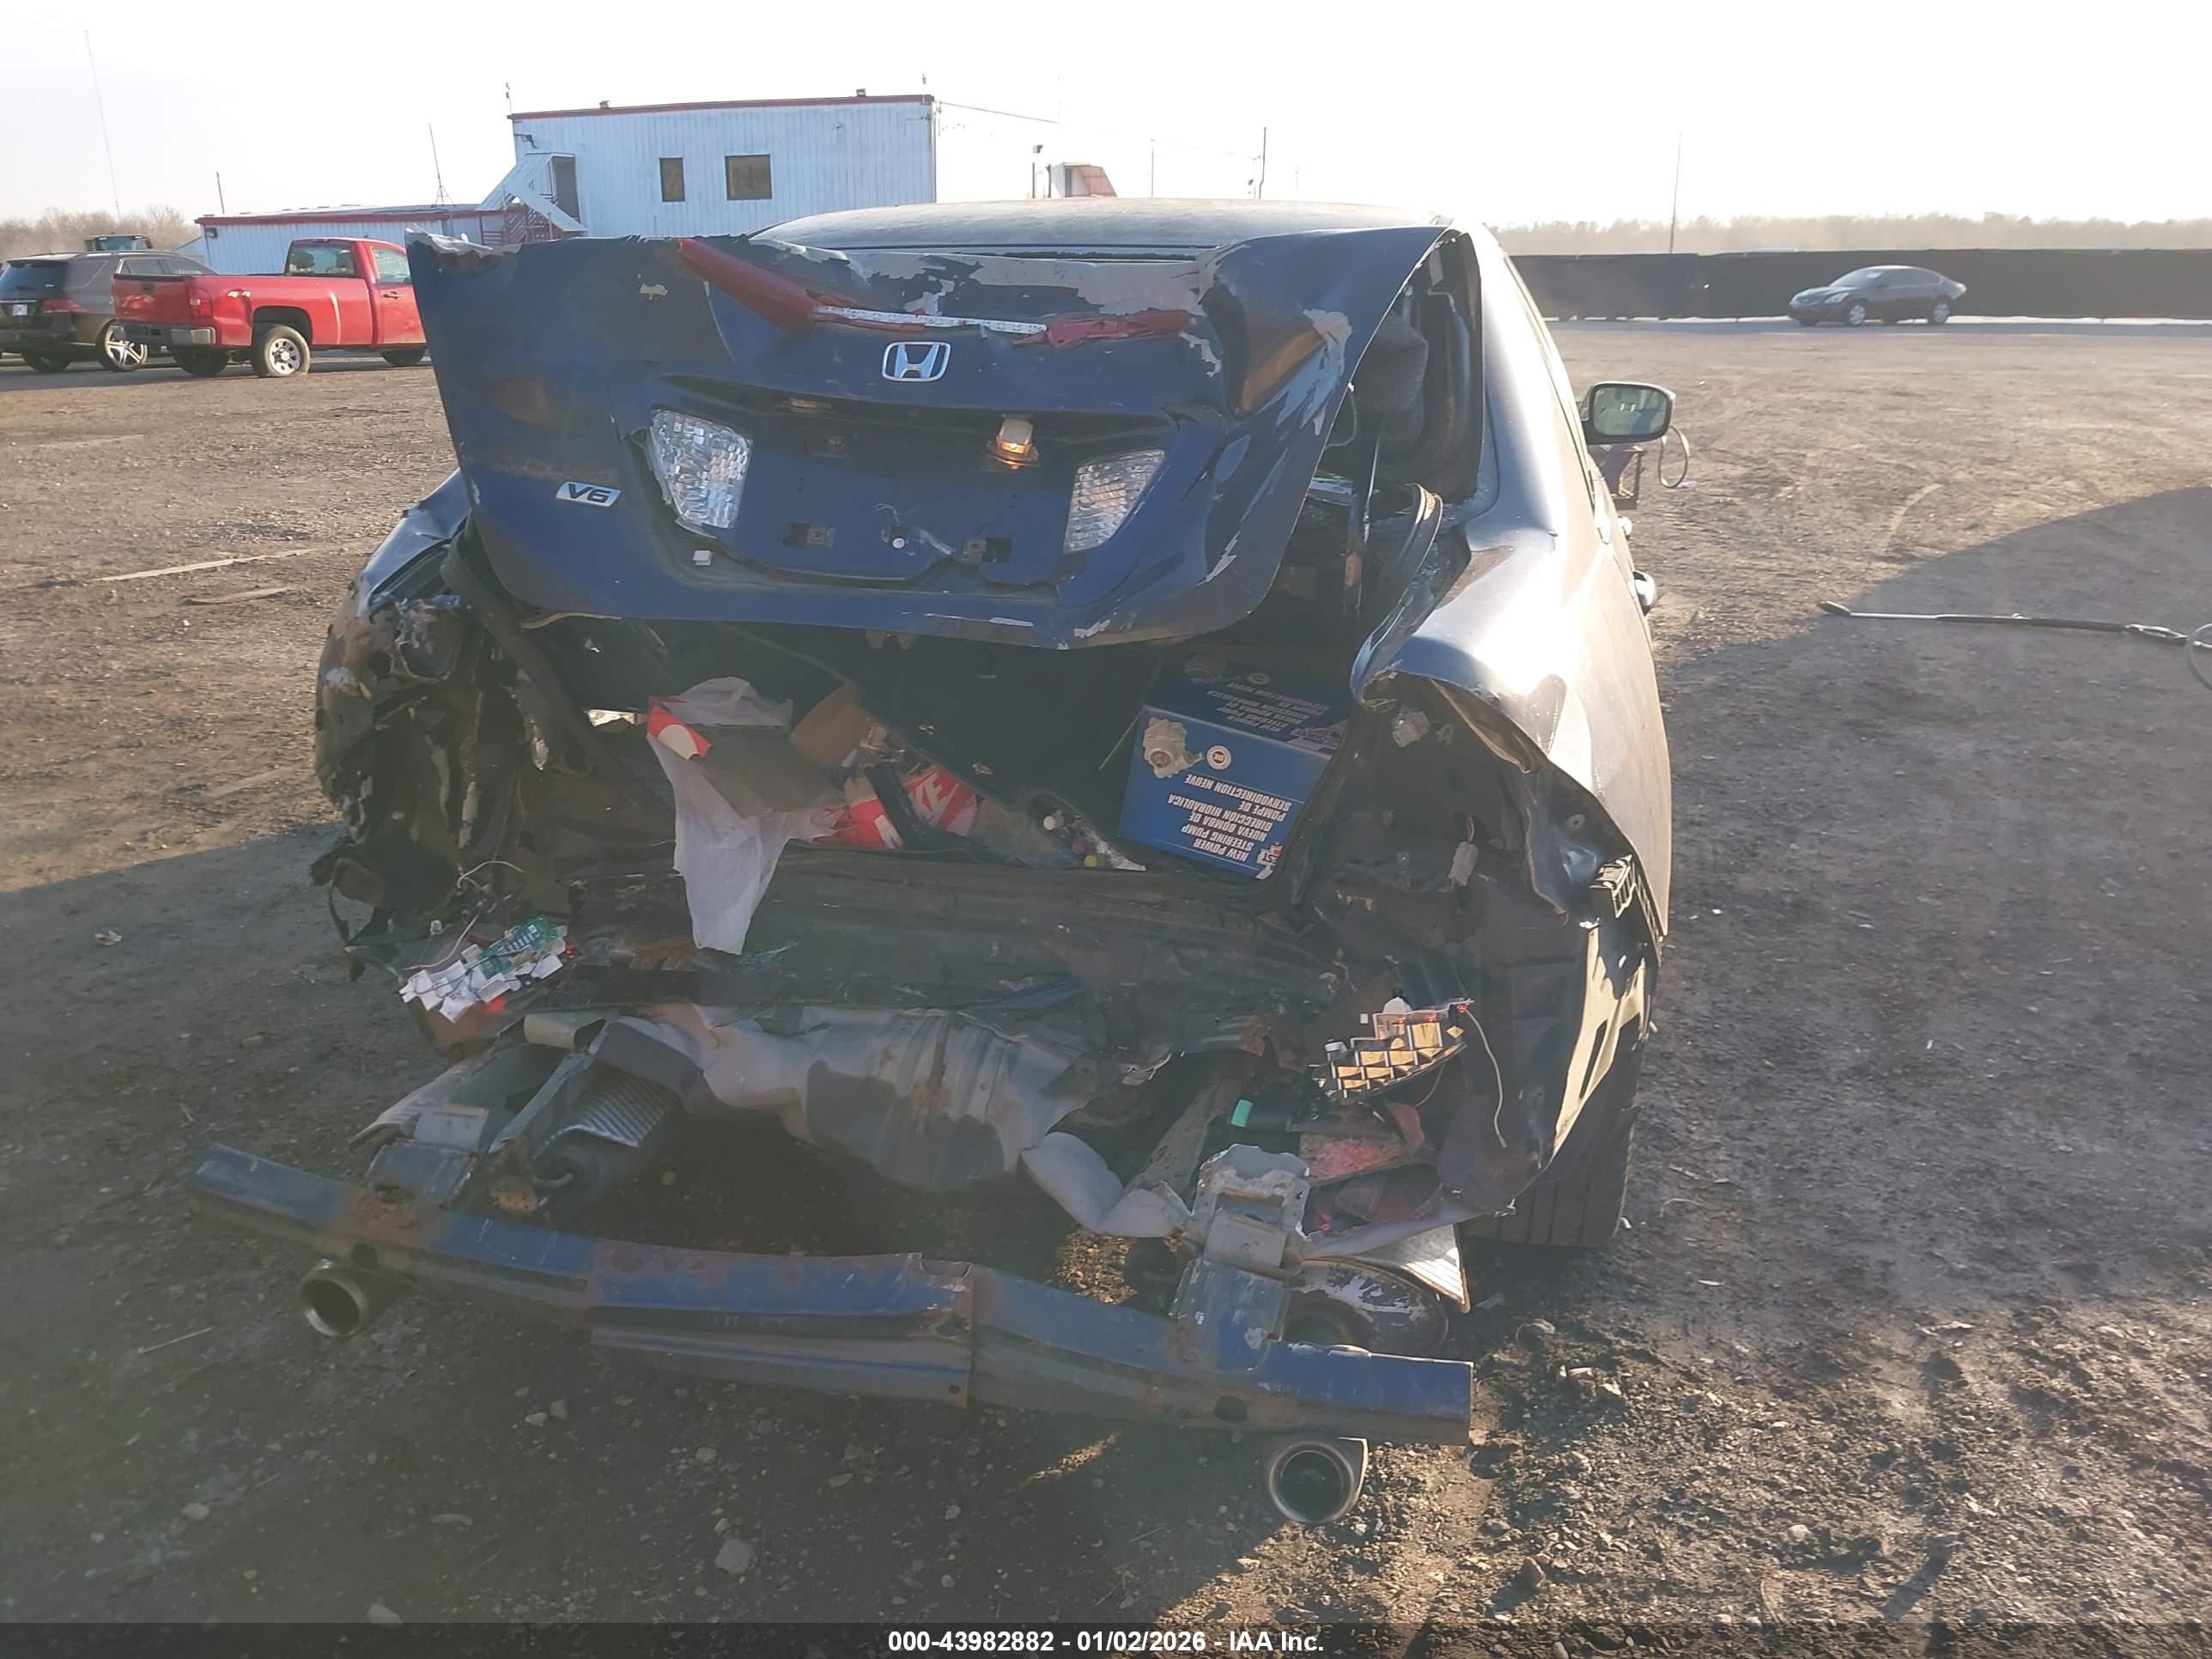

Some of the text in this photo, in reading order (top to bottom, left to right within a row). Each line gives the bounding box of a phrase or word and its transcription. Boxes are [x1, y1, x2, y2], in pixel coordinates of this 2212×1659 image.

[568, 483, 612, 503] V6
[1183, 774, 1214, 790] NEUVE
[1237, 801, 1287, 822] POMPE DE
[1188, 812, 1268, 842] NUEVA BOMBA DE
[1181, 823, 1255, 852] STEERING PUMP
[1193, 838, 1227, 855] POWER
[1226, 849, 1250, 862] NEW
